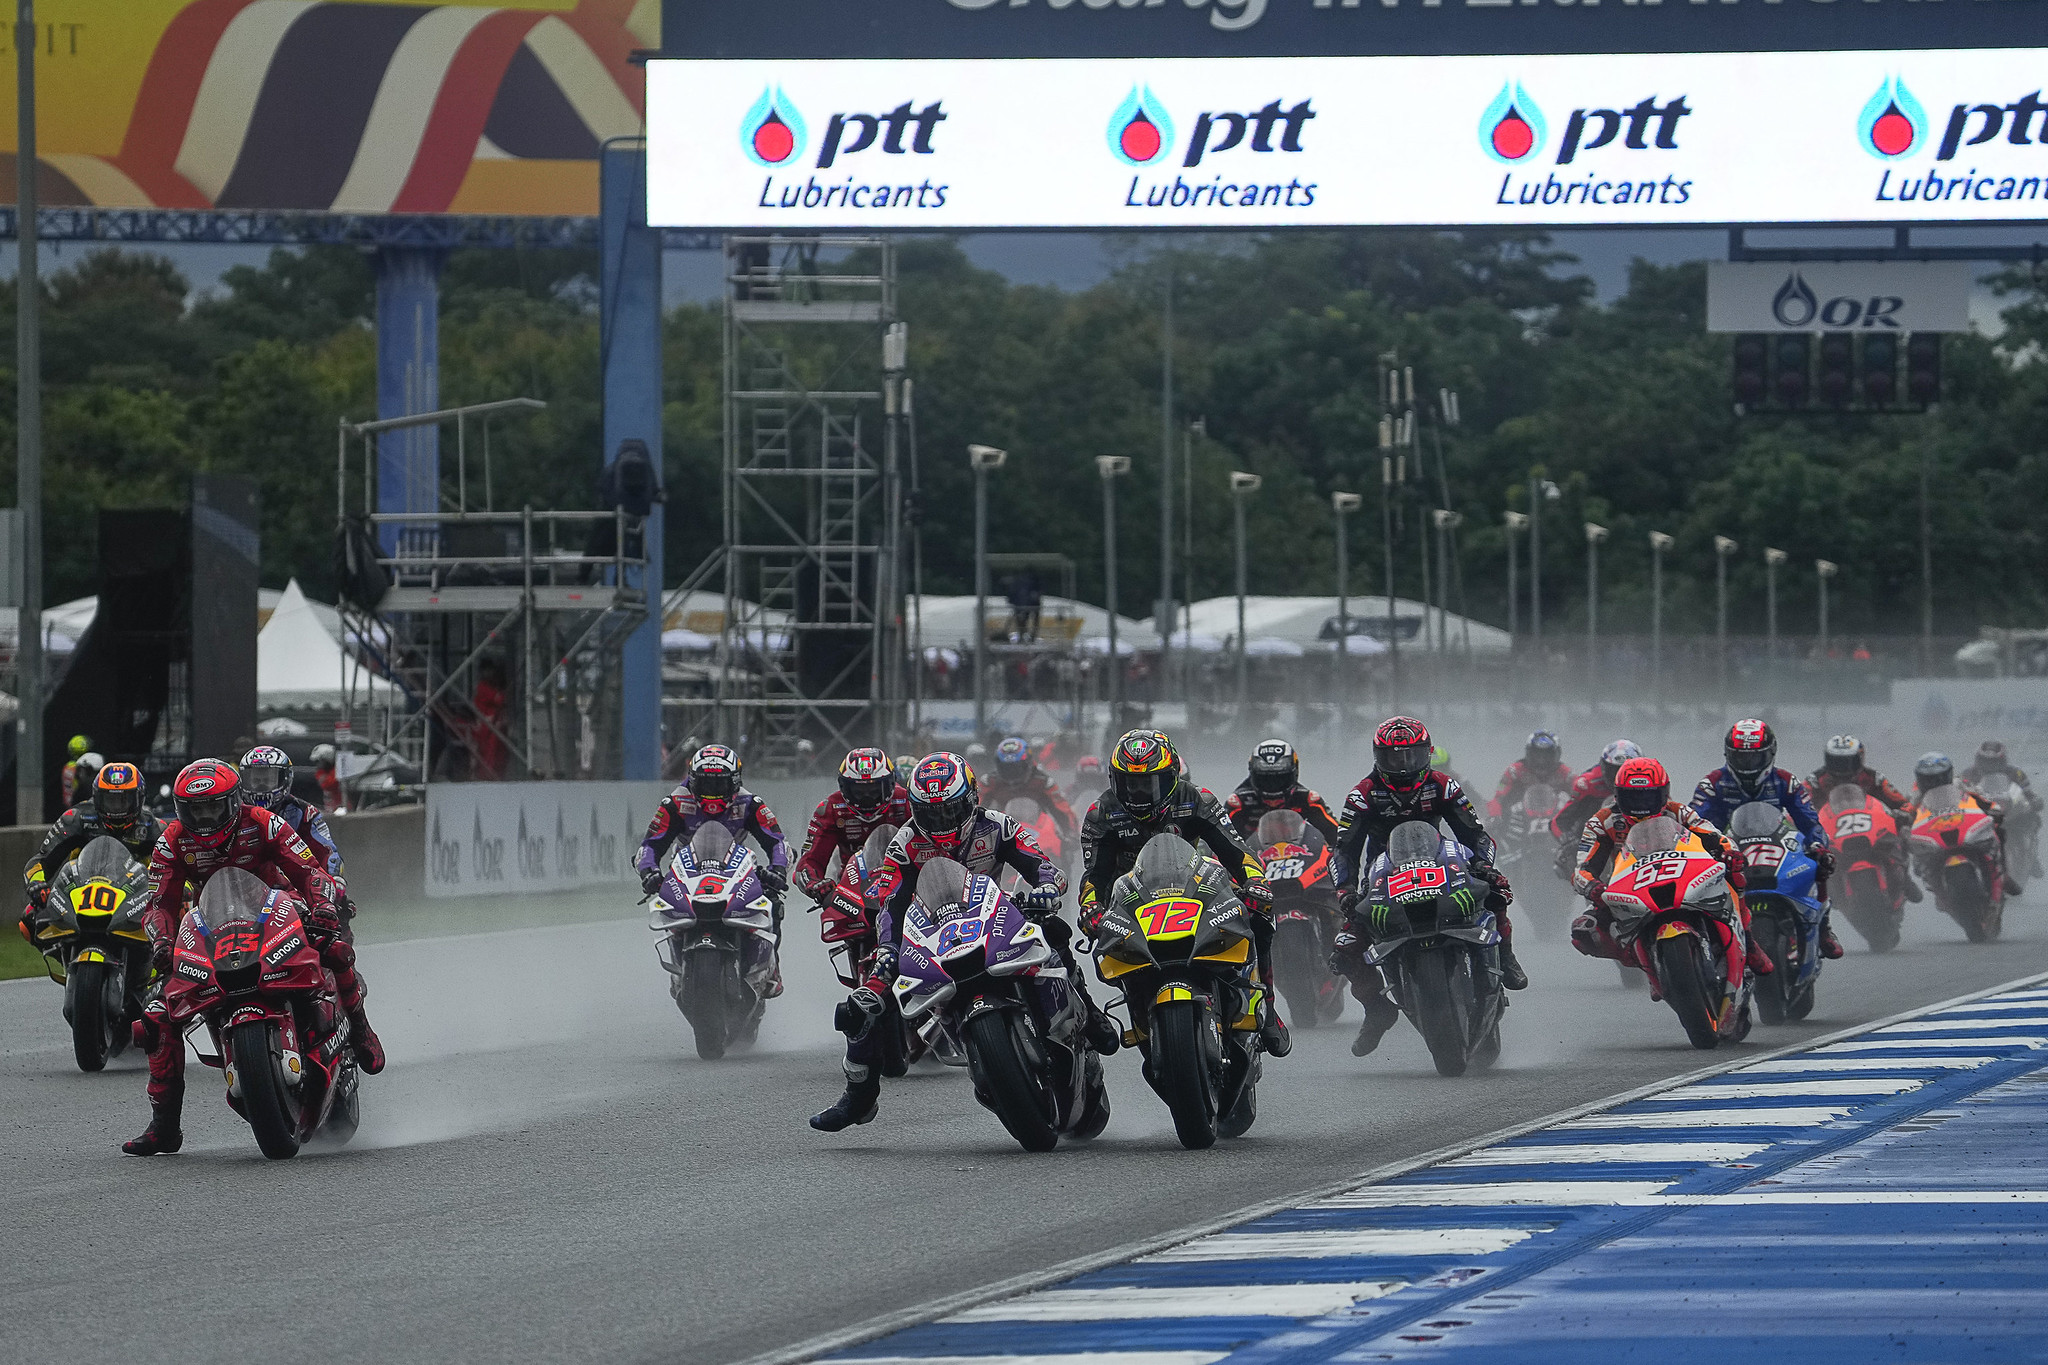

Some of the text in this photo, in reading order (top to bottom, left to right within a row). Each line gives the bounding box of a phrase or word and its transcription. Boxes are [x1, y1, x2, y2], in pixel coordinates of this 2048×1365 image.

[816, 99, 948, 169] ptt
[1182, 97, 1317, 168] ptt
[1556, 94, 1693, 165] ptt
[759, 176, 949, 210] Lubricants
[1125, 174, 1318, 208] Lubricants
[1496, 172, 1694, 206] Lubricants
[1875, 168, 2048, 202] Lubricant
[1821, 294, 1905, 328] OR
[921, 789, 950, 799] SHARK
[1118, 827, 1139, 838] FILA
[1834, 813, 1872, 838] 25
[1739, 836, 1772, 844] SUZUKI
[680, 847, 693, 869] OCTO
[731, 847, 746, 868] OCTO
[1400, 860, 1437, 872] ENEOS
[1632, 851, 1687, 872] REPSOL
[1265, 858, 1305, 882] 88
[1387, 865, 1447, 899] 20
[1633, 859, 1688, 892] 93
[1691, 865, 1724, 889] HONDA
[666, 877, 684, 901] prima
[693, 875, 729, 897] 5
[736, 876, 755, 901] prima
[972, 875, 987, 902] OCTO
[1396, 888, 1443, 903] MONSTER
[78, 886, 118, 912] 10
[833, 896, 860, 916] Lenovo
[936, 902, 960, 917] FIAMM
[1606, 894, 1639, 905] HONDA
[908, 904, 926, 927] OCTO
[938, 912, 963, 927] prima
[993, 906, 1008, 937] prima
[1140, 901, 1202, 936] 72
[1208, 905, 1243, 928] mooney
[937, 919, 984, 957] 89
[1103, 919, 1134, 940] mooney
[214, 933, 260, 960] 63
[266, 937, 300, 965] Lenovo
[903, 946, 929, 970] prima
[178, 962, 209, 980] Lenovo
[232, 1006, 264, 1019] enovo
